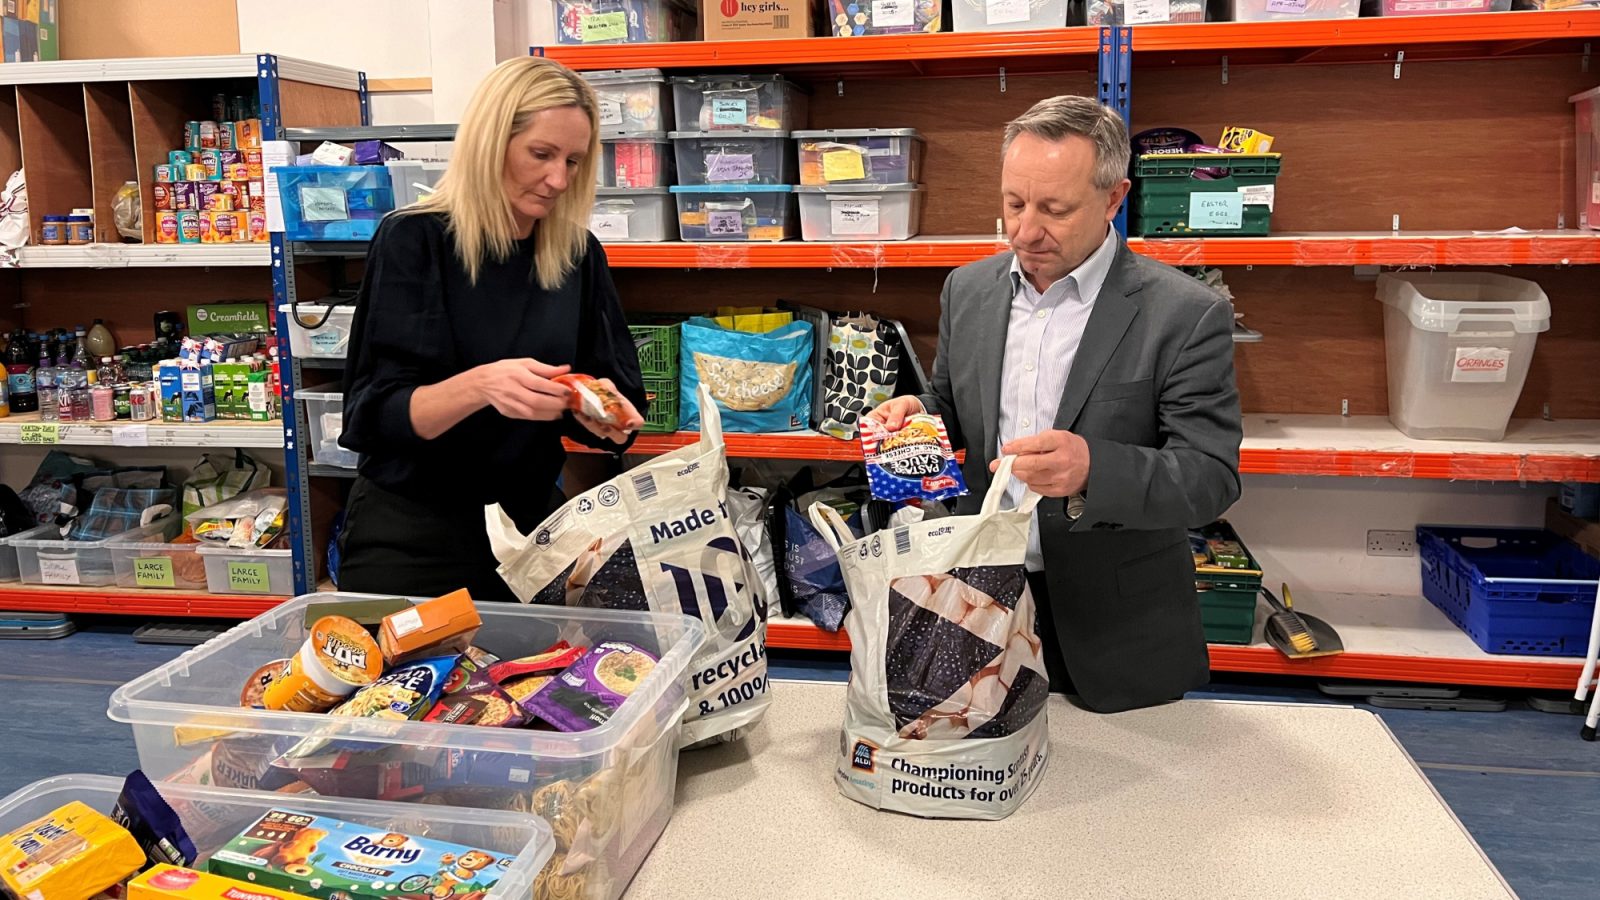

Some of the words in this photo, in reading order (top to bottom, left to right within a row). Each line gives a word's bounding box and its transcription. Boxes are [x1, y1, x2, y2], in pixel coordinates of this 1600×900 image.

[741, 2, 757, 13] hey
[759, 2, 789, 13] girls...
[1201, 200, 1228, 208] EASTER
[210, 311, 260, 322] Creamfields
[1456, 357, 1505, 369] ORANGES
[706, 362, 730, 397] Say
[734, 368, 787, 399] cheese!
[884, 447, 911, 459] CHEESE
[890, 454, 939, 468] SAUCE
[906, 463, 940, 475] PASTA
[650, 508, 716, 544] Made
[137, 563, 164, 572] LARGE
[231, 568, 258, 576] LARGE
[137, 571, 165, 580] FAMILY
[231, 576, 261, 584] FAMILY
[322, 639, 367, 669] POT
[698, 700, 715, 716] &
[854, 756, 871, 766] ALDI
[891, 757, 1005, 785] Championing
[891, 777, 965, 800] products
[970, 787, 995, 802] for
[999, 779, 1020, 802] over
[344, 835, 421, 864] Barny
[338, 863, 386, 876] CHOCOLATE
